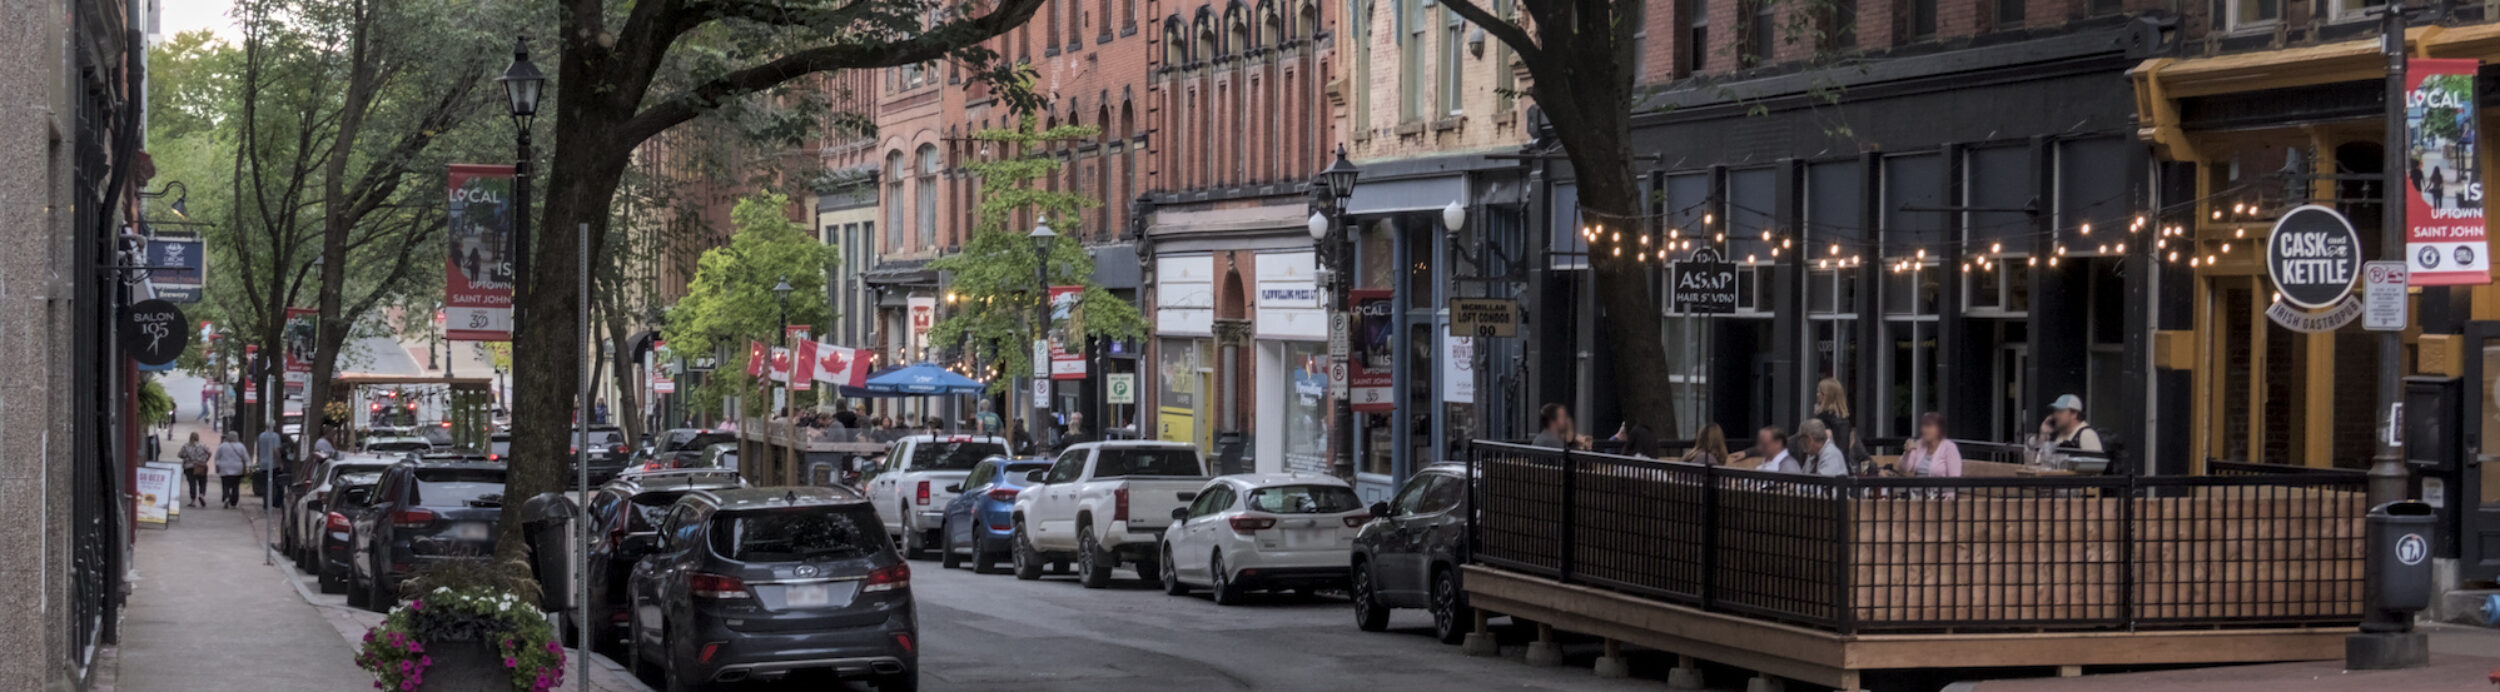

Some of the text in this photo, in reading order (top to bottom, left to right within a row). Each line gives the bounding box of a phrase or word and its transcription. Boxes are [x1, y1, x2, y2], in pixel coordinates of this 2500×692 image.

[2405, 90, 2463, 108] LOCAL
[449, 188, 501, 203] LOCAL
[2464, 183, 2482, 201] IS
[2431, 208, 2483, 219] UPTOWN
[2413, 225, 2484, 237] SAINT JOHN
[2280, 232, 2328, 257] CASK
[497, 262, 512, 276] IS
[2282, 259, 2348, 284] KETTLE
[468, 281, 512, 290] UPTOWN
[1678, 271, 1733, 290] ASAP
[453, 294, 512, 304] SAINT JOHN
[1676, 293, 1734, 303] HAIR SUDIO
[1350, 306, 1384, 316] LOCAL
[2273, 304, 2300, 327] IRISH
[2303, 301, 2359, 330] GASTROPUB
[134, 312, 174, 322] SALON
[1458, 312, 1509, 323] LOFT CONDOS
[1379, 355, 1391, 366] IS
[1352, 377, 1372, 385] SAINT
